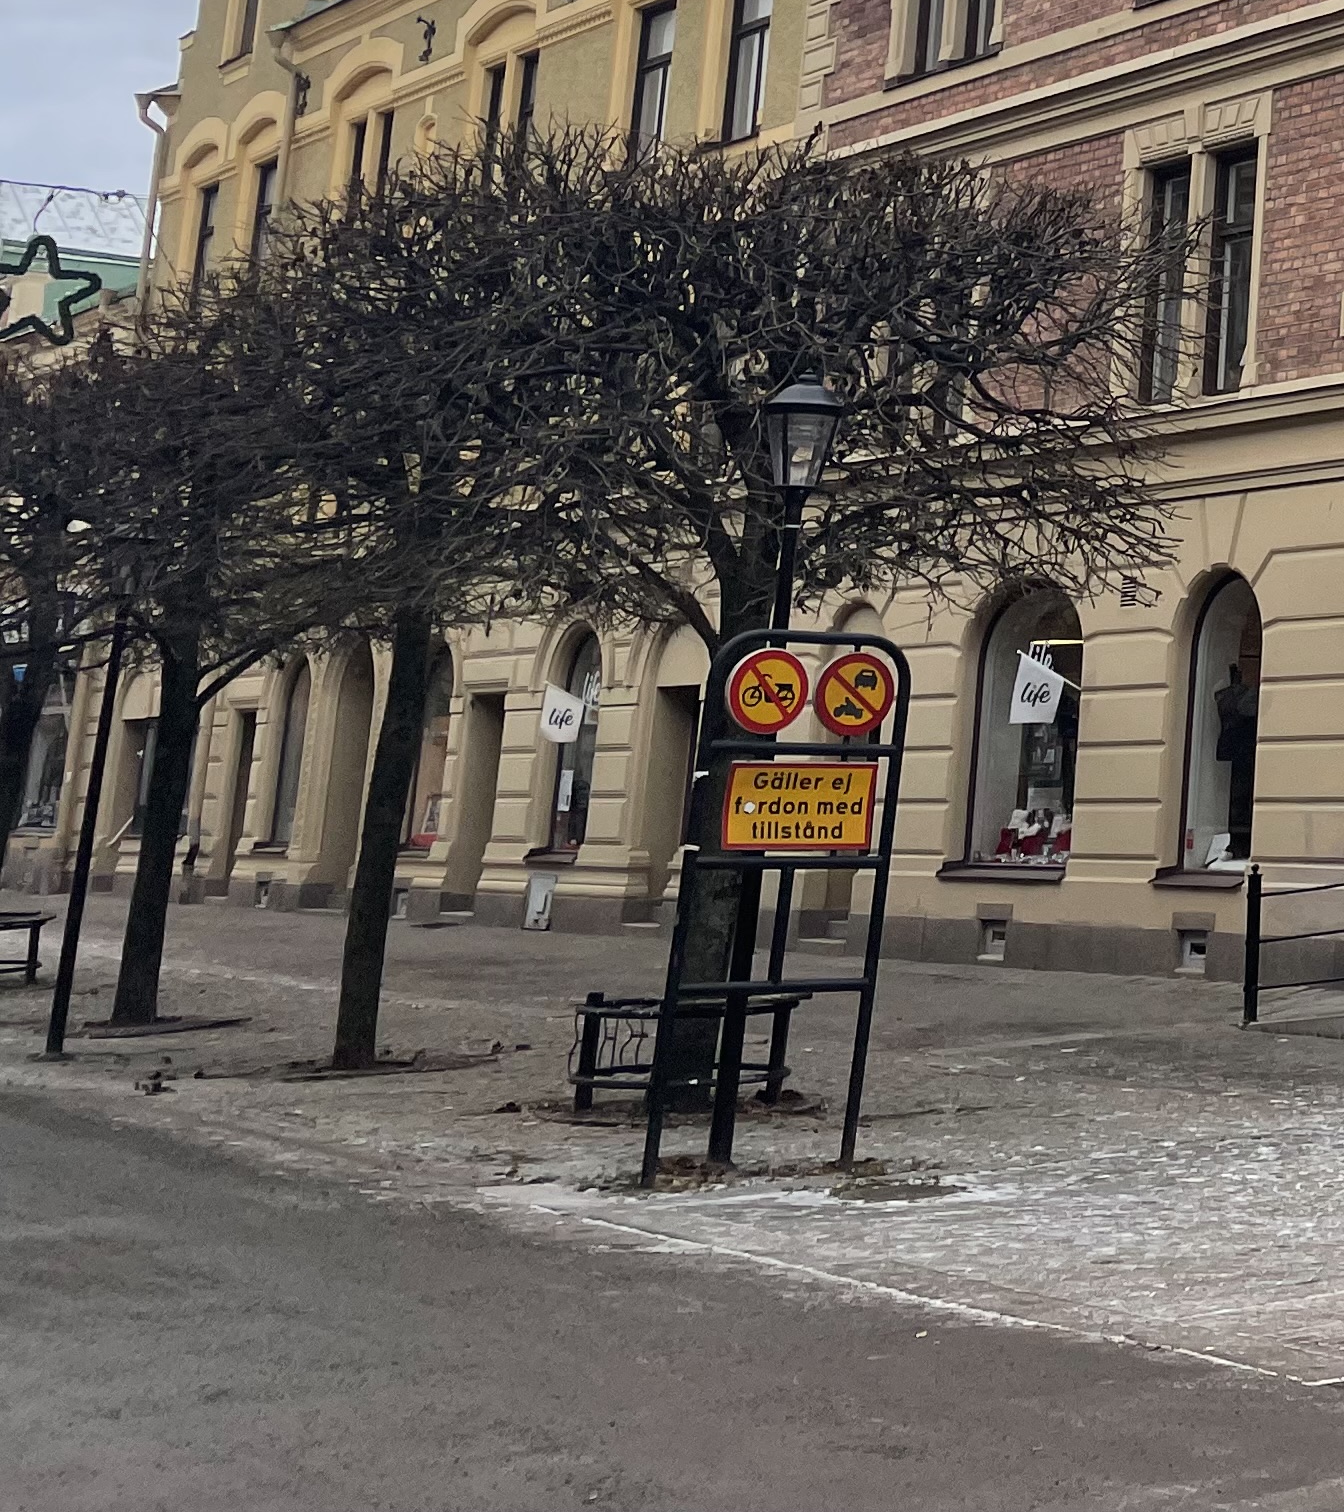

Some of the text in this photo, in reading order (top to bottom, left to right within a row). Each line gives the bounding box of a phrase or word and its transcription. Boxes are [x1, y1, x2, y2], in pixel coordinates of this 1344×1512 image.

[1020, 682, 1051, 707] life
[548, 707, 574, 730] life
[753, 771, 853, 795] Gäller ej
[734, 796, 863, 816] frdon med
[752, 820, 843, 840] tillstånd
